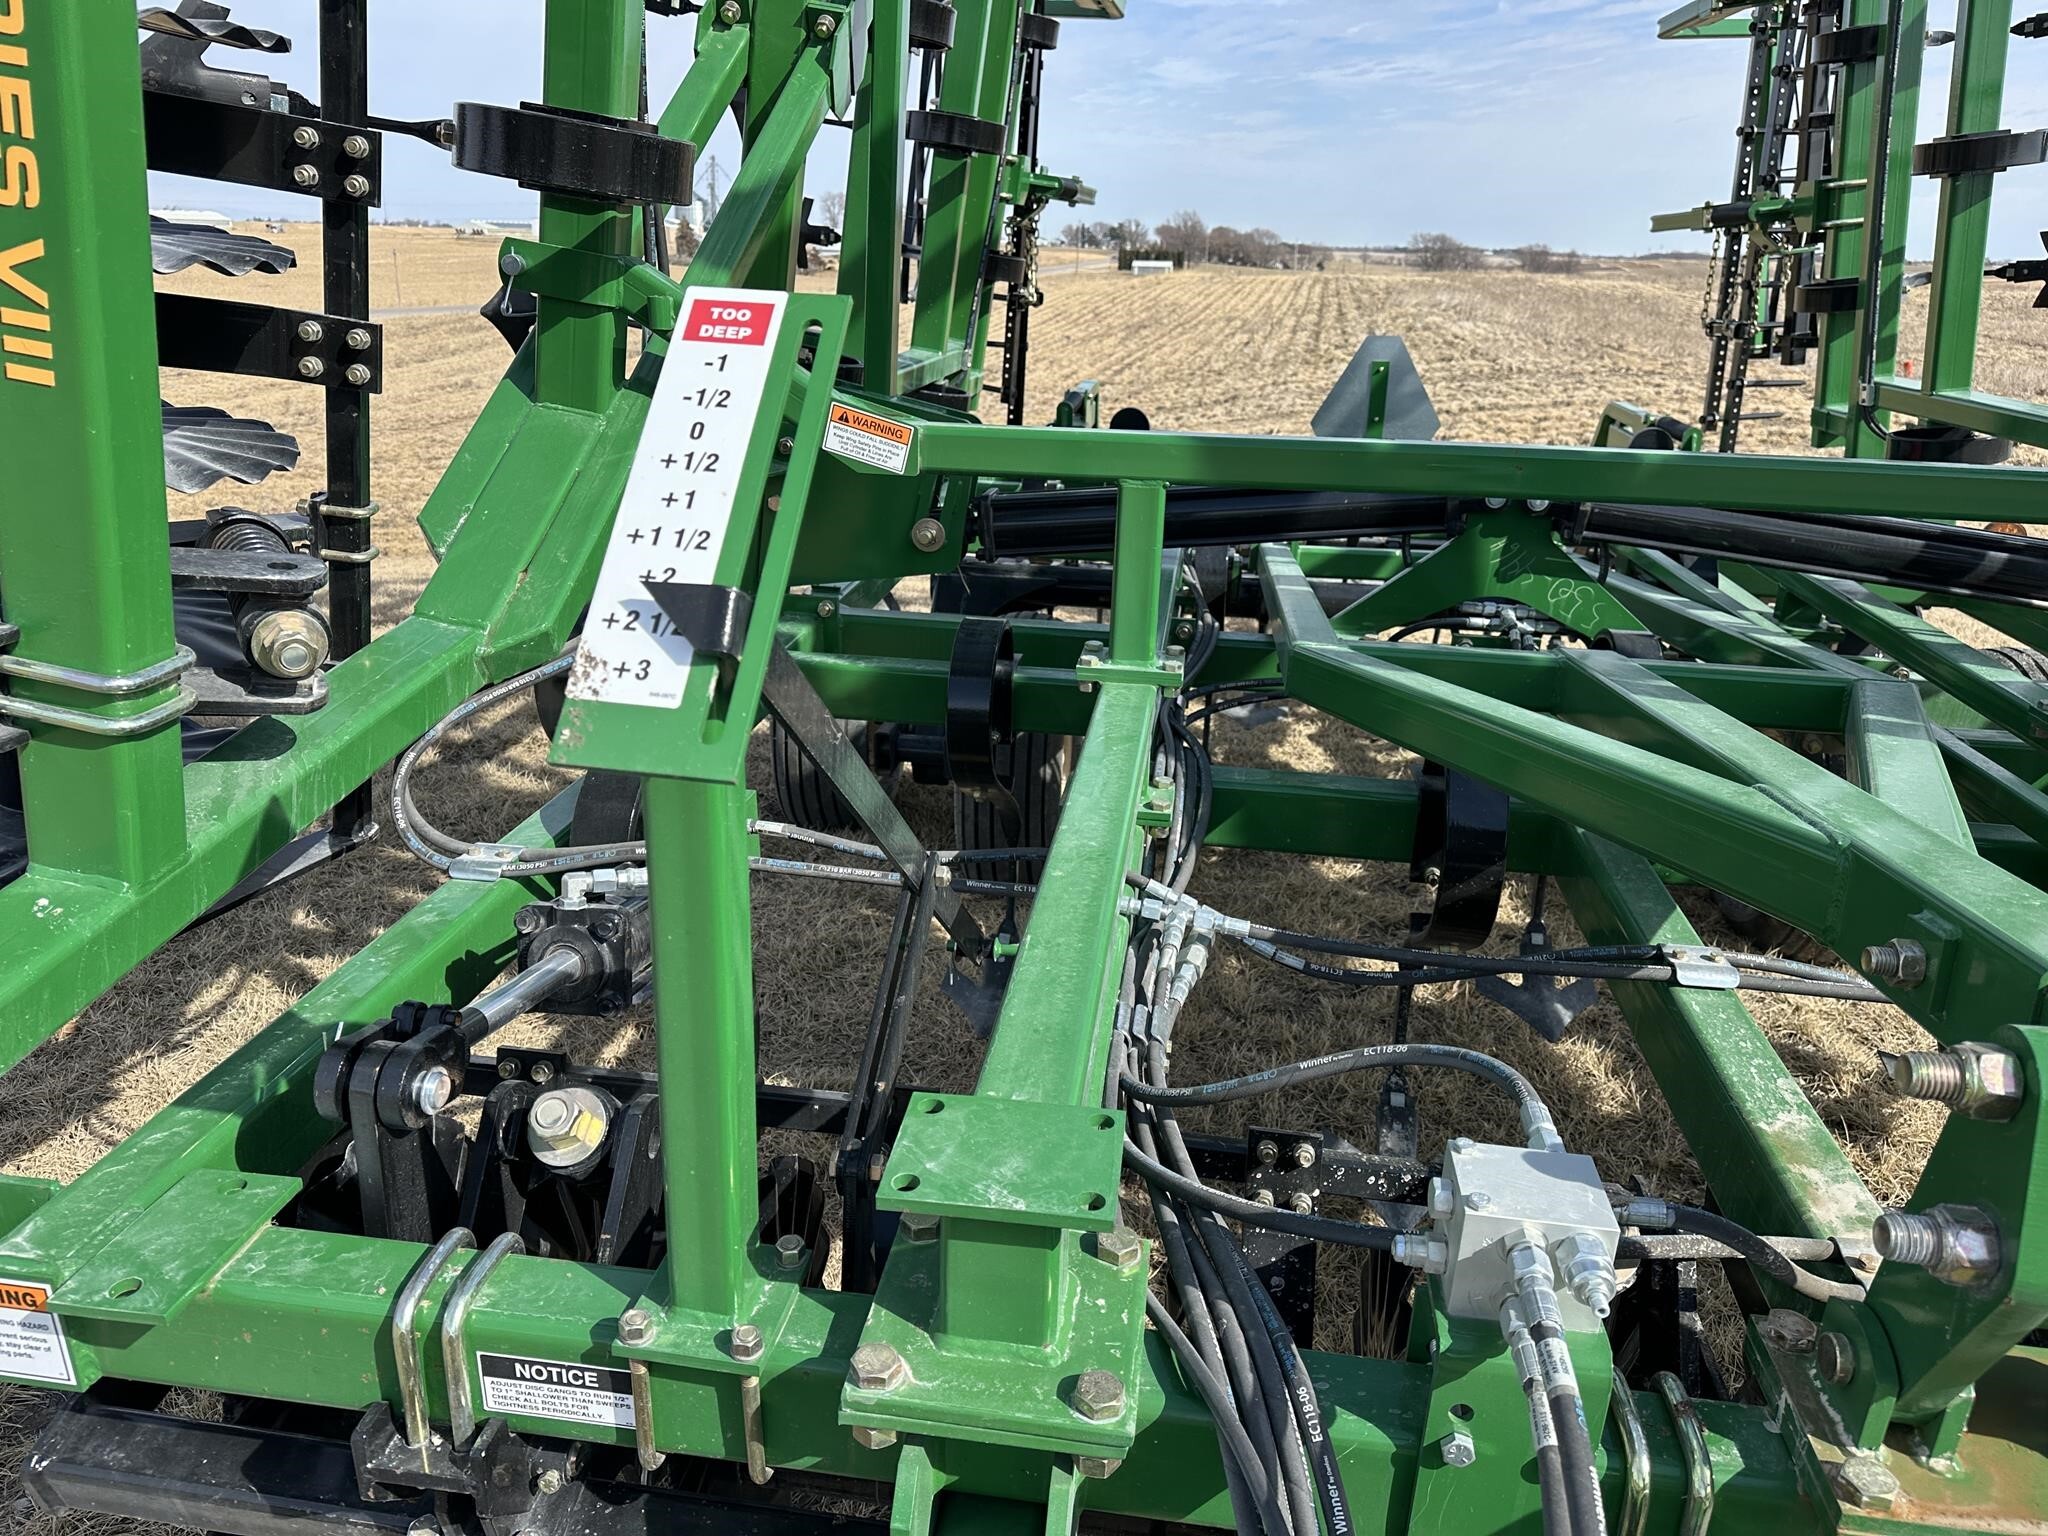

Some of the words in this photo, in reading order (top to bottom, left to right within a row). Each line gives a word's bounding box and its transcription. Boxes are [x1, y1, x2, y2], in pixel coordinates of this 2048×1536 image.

[0, 238, 56, 386] VIII
[710, 307, 752, 322] TOO
[698, 324, 752, 340] DEEP
[704, 354, 729, 373] -1
[682, 388, 732, 410] -1/2
[689, 421, 705, 441] 0
[852, 415, 903, 439] WARNING
[833, 425, 849, 434] WINGS
[849, 430, 866, 439] COULD
[866, 435, 877, 443] FALL
[879, 439, 904, 451] SUDDENLY
[833, 432, 845, 440] Keep
[845, 435, 857, 444] Wing
[857, 439, 872, 449] Safety
[674, 529, 711, 551] 1/2
[399, 752, 417, 775] Winner
[966, 879, 992, 889] Winner
[1737, 953, 1767, 965] Winner
[1310, 963, 1343, 976] EC118-06
[1366, 971, 1393, 979] Winner
[1299, 1055, 1333, 1070] Winner
[1363, 1045, 1408, 1056] EC118-06
[16, 1321, 49, 1331] HAZARD
[5, 1342, 21, 1350] stay
[23, 1343, 42, 1351] clear
[19, 1335, 48, 1343] serious
[514, 1362, 599, 1388] NOTICE
[490, 1380, 523, 1389] ADJUST
[524, 1384, 545, 1392] DISC
[547, 1387, 577, 1396] GANGS
[491, 1393, 522, 1402] CHECK
[523, 1397, 539, 1405] ALL
[541, 1399, 569, 1408] BOLTS
[571, 1403, 589, 1411] FOR
[493, 1400, 540, 1412] TIGHTNESS
[541, 1405, 605, 1419] PERIODICALLY.
[515, 1390, 568, 1402] SHALLOWER
[569, 1396, 594, 1405] THAN
[595, 1399, 633, 1410] SWEEPS.
[1296, 1386, 1324, 1443] EC118-06
[1327, 1483, 1348, 1535] Winner
